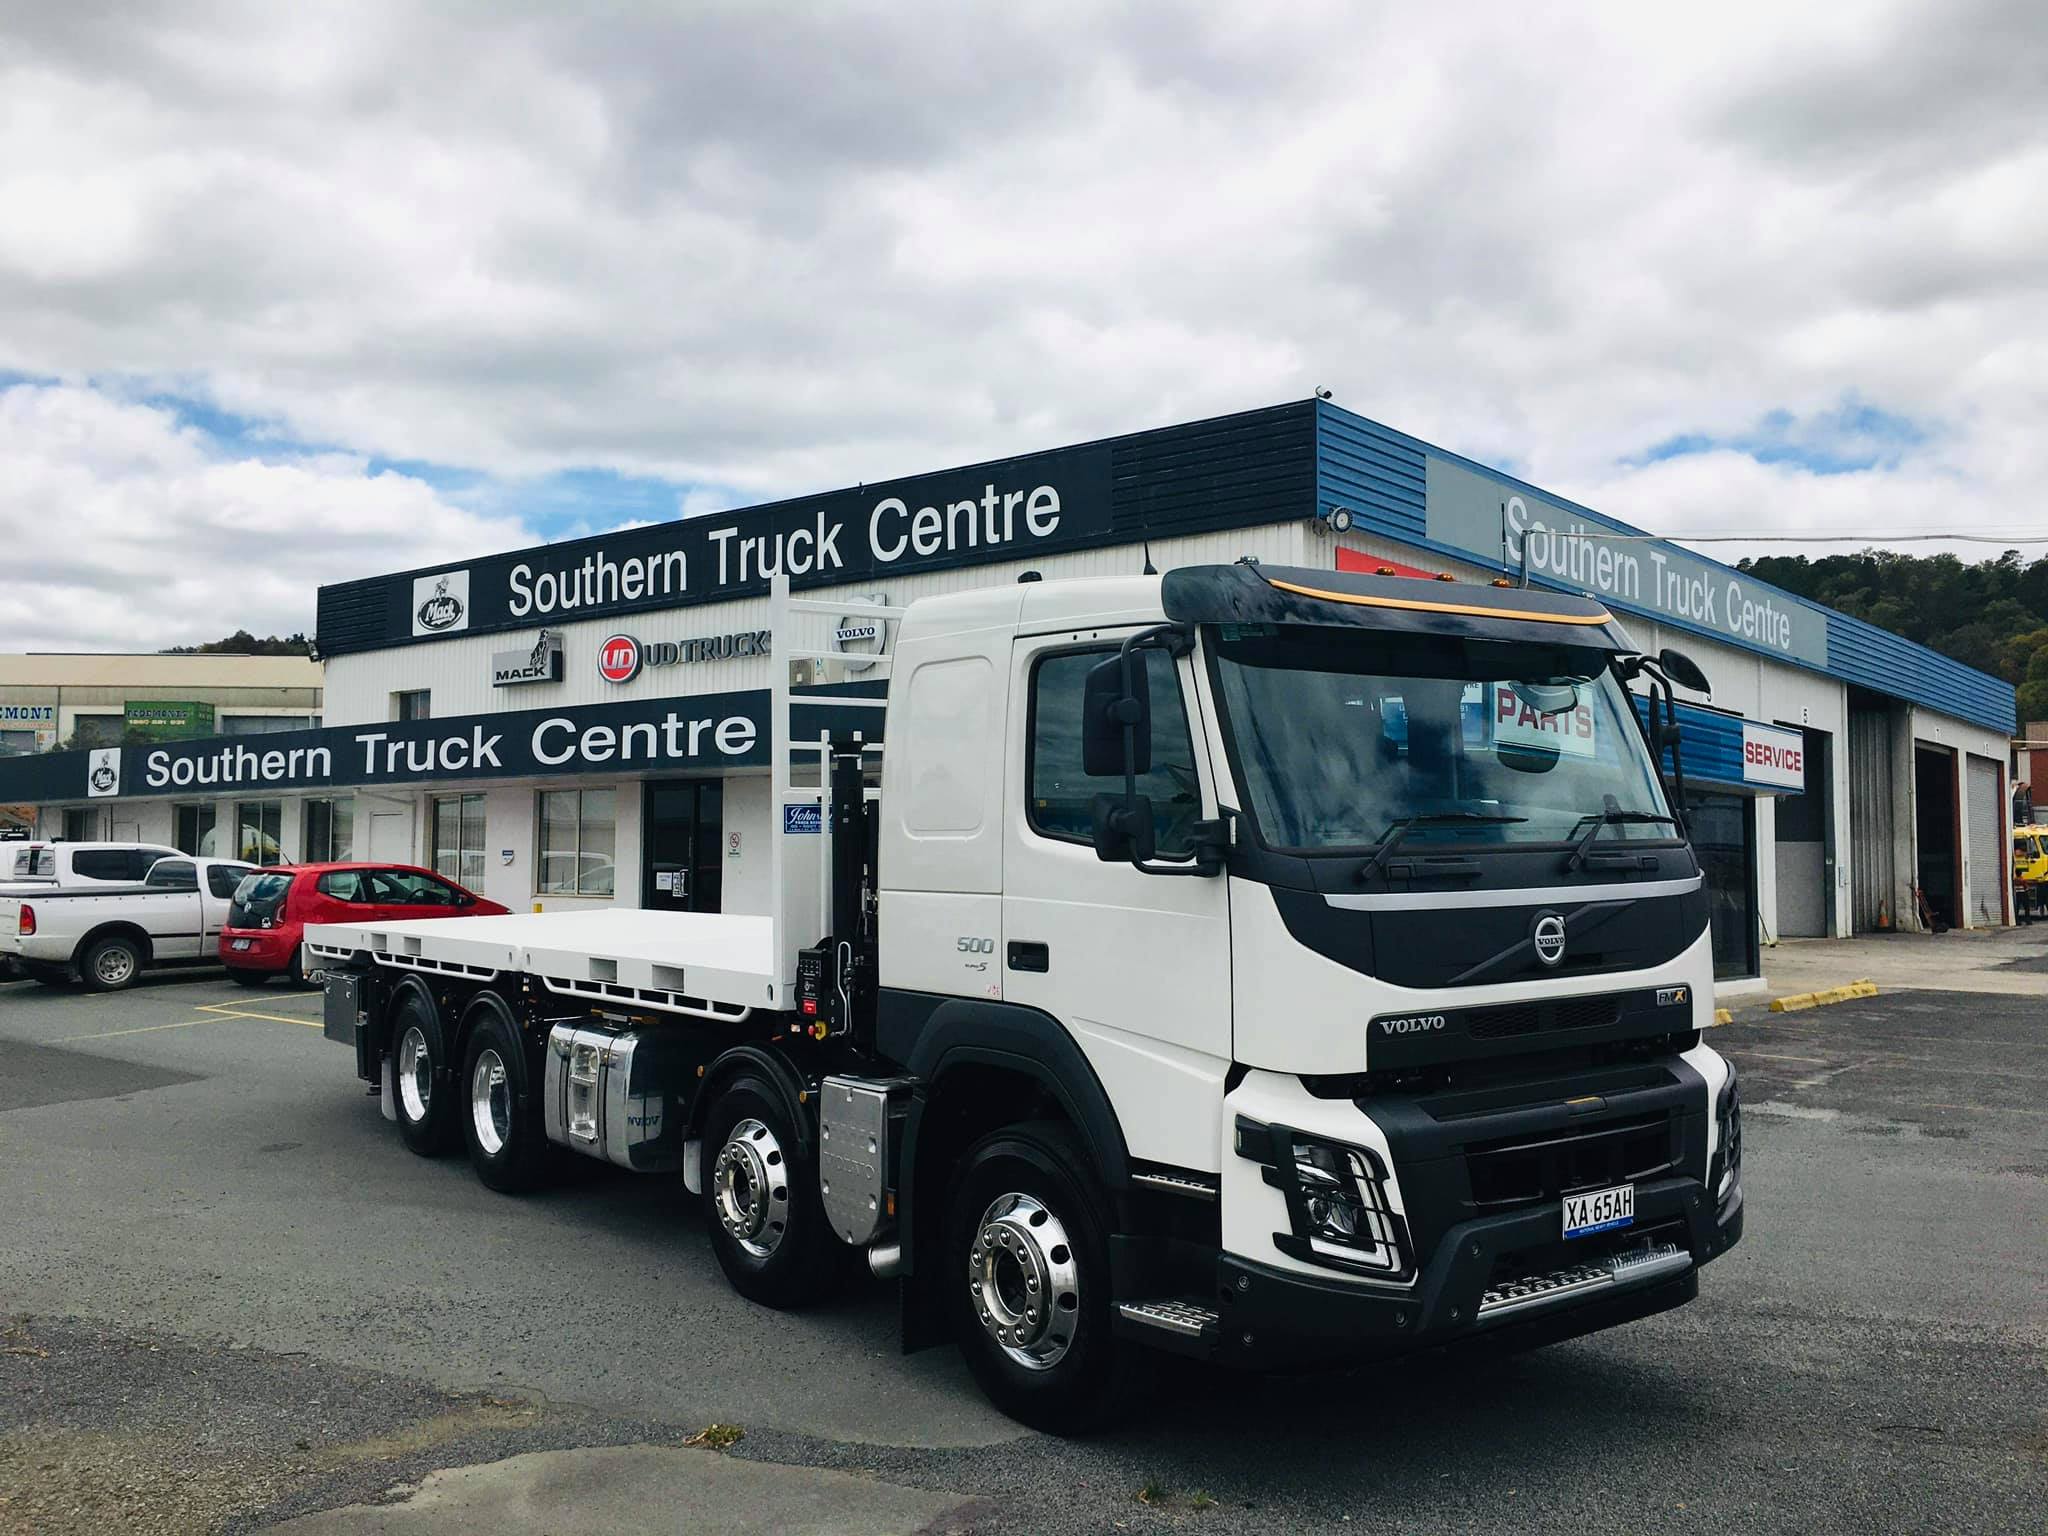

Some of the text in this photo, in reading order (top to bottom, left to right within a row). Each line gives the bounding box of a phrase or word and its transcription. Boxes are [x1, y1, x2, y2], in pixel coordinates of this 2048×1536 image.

[509, 483, 1061, 617] Southern Truck Centre
[1506, 496, 1790, 650] Southern Truck Centre
[424, 600, 455, 621] Mack
[836, 627, 876, 639] VOLVO
[602, 648, 634, 670] UD
[643, 630, 772, 668] UD TRUCK
[495, 666, 546, 681] MACK
[0, 706, 53, 720] MONT
[145, 712, 757, 787] Southern Truck Centre
[1745, 741, 1802, 773] SERVICE
[957, 937, 995, 953] 500
[1537, 937, 1565, 945] VOLVO
[1379, 1015, 1446, 1035] VOLVO
